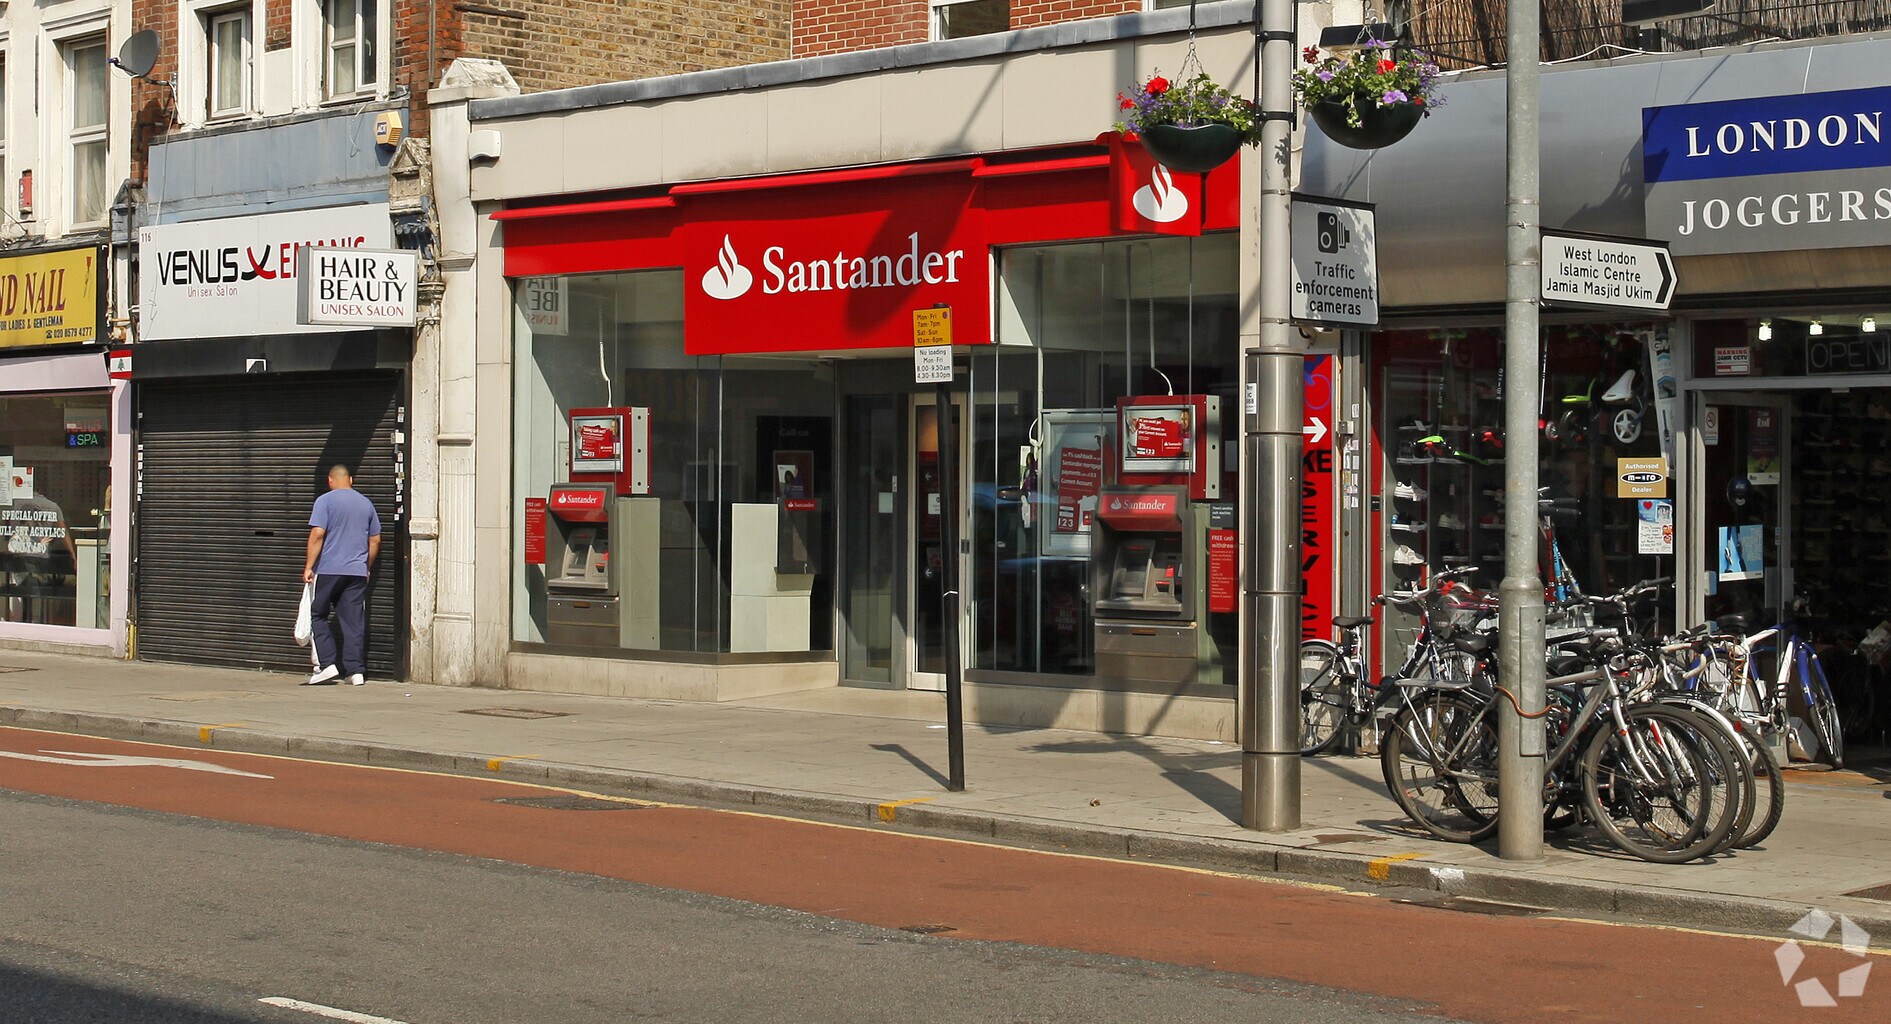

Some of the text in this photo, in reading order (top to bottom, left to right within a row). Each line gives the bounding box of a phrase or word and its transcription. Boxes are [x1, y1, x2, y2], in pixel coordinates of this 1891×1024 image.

[1684, 111, 1883, 158] LONDON
[1678, 187, 1891, 236] JOGGERS
[141, 232, 152, 242] 116
[762, 231, 964, 295] Santander
[1563, 245, 1637, 266] West London
[157, 246, 239, 286] VENUS
[321, 255, 377, 280] HAIR
[384, 259, 400, 280] &
[1314, 260, 1356, 280] Traffic
[1560, 262, 1641, 283] Islamic Centre
[23, 268, 67, 315] NAIL
[187, 284, 238, 298] Unisex Salon
[319, 278, 408, 303] BEAUTY
[1295, 279, 1374, 300] enforcement
[1546, 277, 1653, 300] Jamia Masjid Ukim
[321, 302, 405, 317] UNISEX SALON
[1309, 299, 1362, 316] cameras
[9, 318, 26, 331] LADIES
[33, 315, 64, 329] GENTLEMAN
[53, 326, 93, 338] 020 8579 4277
[928, 348, 947, 356] loading
[1810, 340, 1886, 369] OPEN
[70, 433, 99, 446] & SPA
[1631, 486, 1653, 494] Dealer
[566, 494, 598, 505] Santander
[1122, 498, 1167, 511] Santander
[1, 510, 58, 523] SPECIAL OFFER
[30, 526, 66, 538] ACRYLICS
[1211, 534, 1223, 542] FREE
